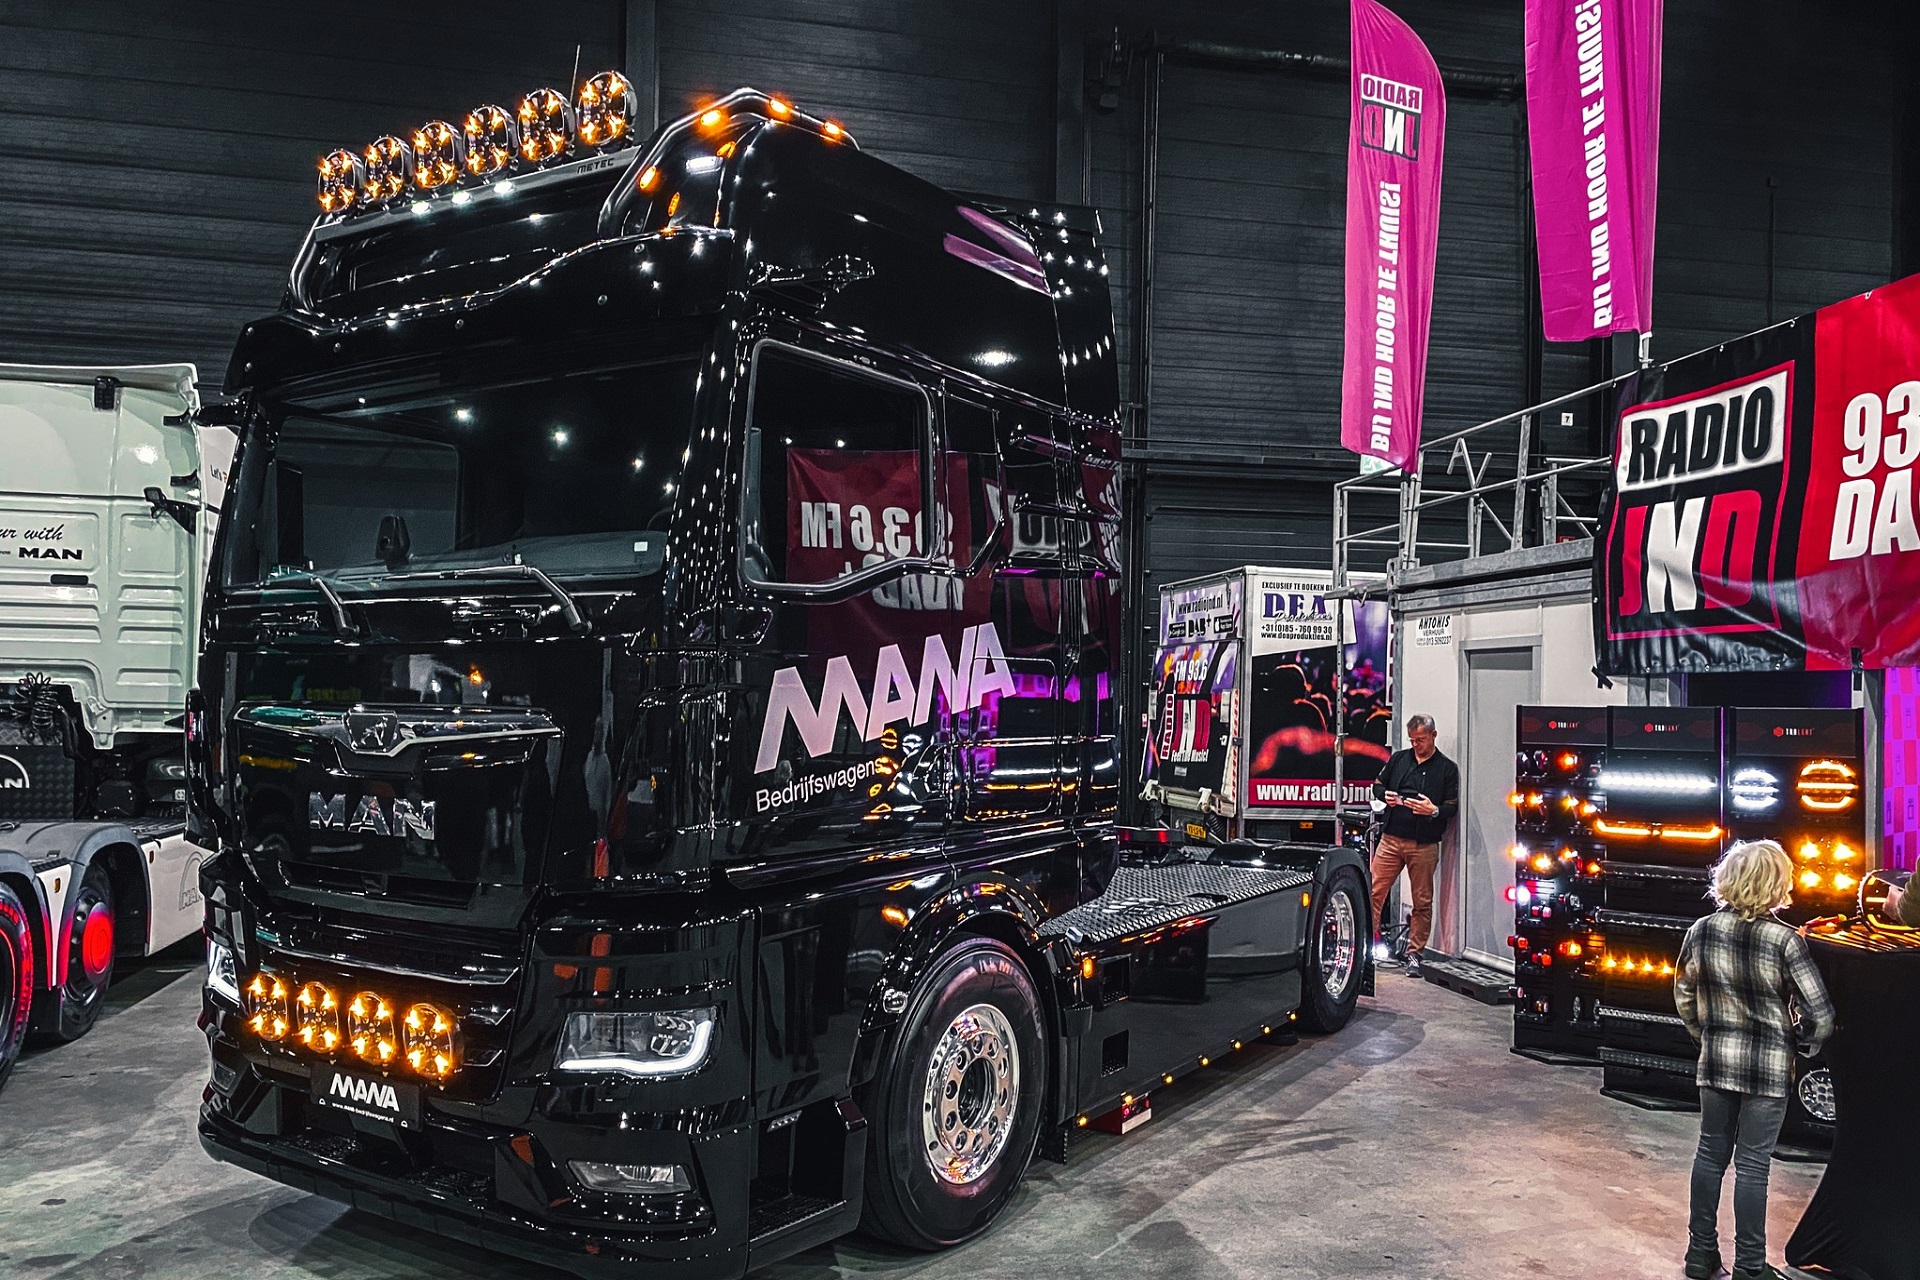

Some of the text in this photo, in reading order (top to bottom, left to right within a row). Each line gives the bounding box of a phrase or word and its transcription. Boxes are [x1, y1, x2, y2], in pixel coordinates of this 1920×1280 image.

[577, 158, 614, 174] METEC
[1626, 385, 1773, 485] RADIO
[24, 524, 64, 540] with
[1829, 467, 1920, 561] DA
[19, 547, 82, 560] MAN
[1618, 489, 1763, 617] JND
[1262, 581, 1293, 590] EXCLUSIEF
[1302, 583, 1325, 591] BOEKEN
[1263, 592, 1327, 618] DEA
[1418, 615, 1450, 630] ANTONIS
[1174, 659, 1208, 681] FM 93.6
[754, 621, 1017, 775] MANA
[1161, 695, 1174, 758] RADIO
[1170, 699, 1211, 752] JND
[756, 756, 884, 812] Bedrijfswagens
[308, 791, 436, 841] MAN
[329, 1072, 400, 1113] MANA
